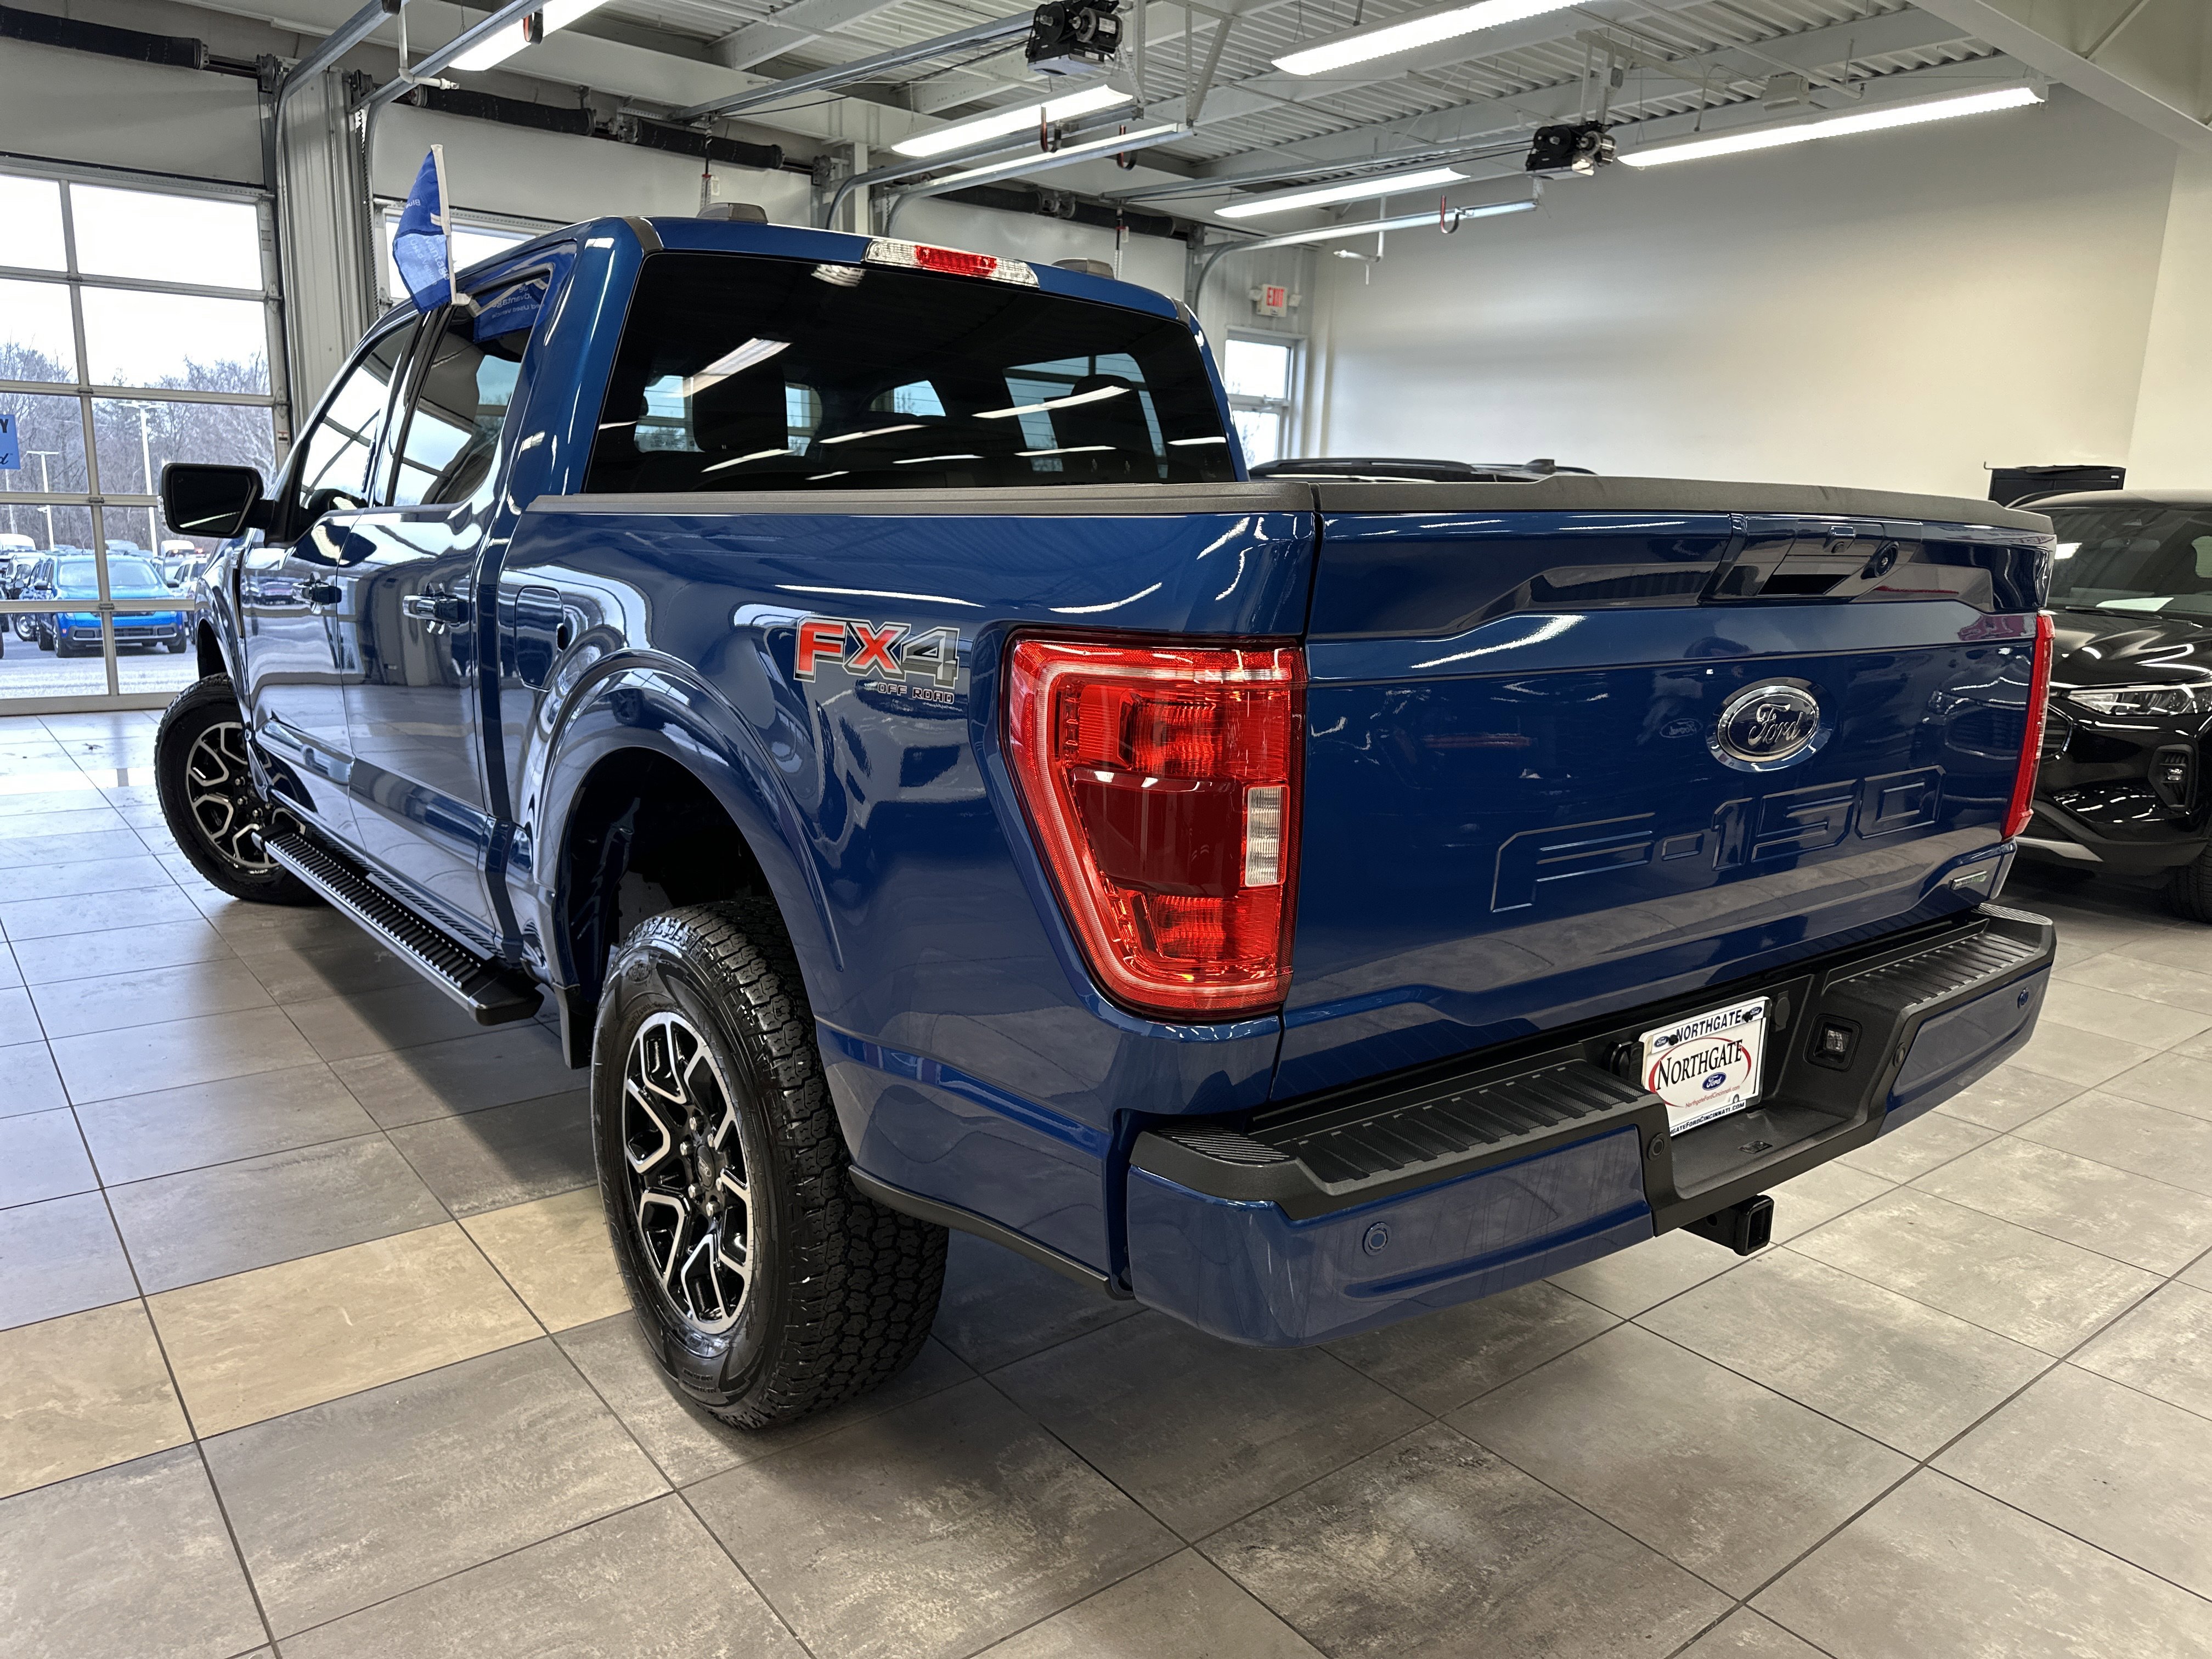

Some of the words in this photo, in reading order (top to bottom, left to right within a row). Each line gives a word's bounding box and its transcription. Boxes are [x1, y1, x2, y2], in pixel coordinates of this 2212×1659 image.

[794, 613, 960, 690] FX4
[878, 682, 907, 696] OFF
[912, 687, 955, 704] ROAD
[1748, 703, 1804, 746] Ford
[1490, 765, 1947, 912] F-150
[1677, 1009, 1742, 1042] NORTHGATE
[1706, 1075, 1723, 1088] Ford
